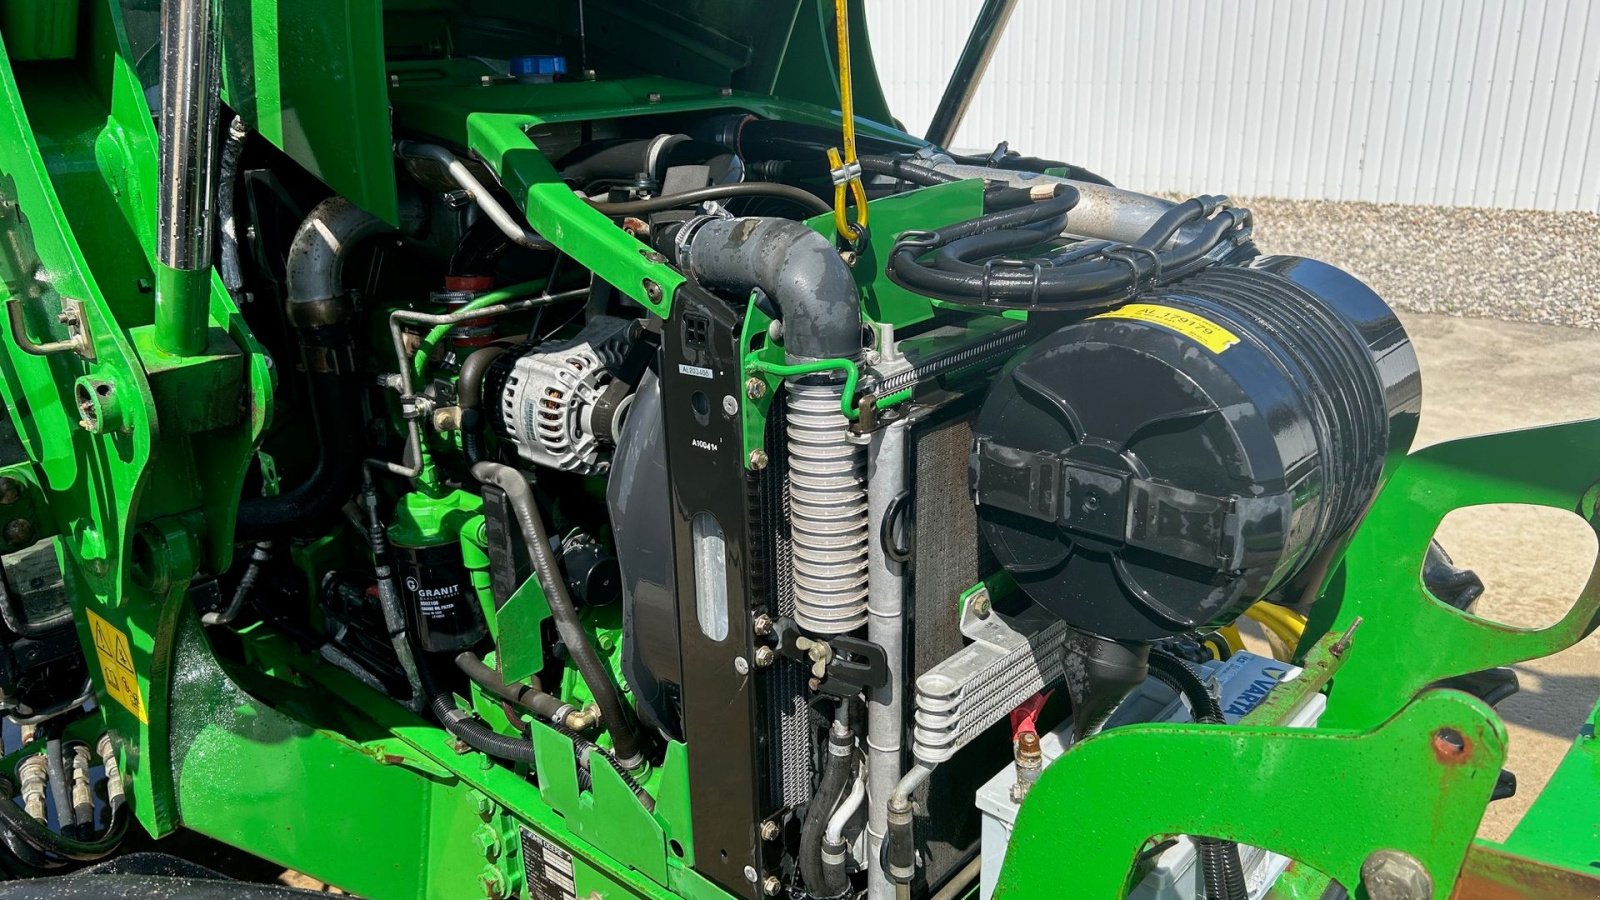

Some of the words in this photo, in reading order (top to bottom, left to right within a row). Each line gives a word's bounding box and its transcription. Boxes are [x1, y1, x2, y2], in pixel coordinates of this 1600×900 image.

[1163, 312, 1214, 335] 179179
[692, 438, 718, 451] A100414
[418, 584, 459, 597] GRANIT
[1224, 679, 1276, 715] VARTA
[527, 832, 542, 845] JOHN
[543, 841, 564, 857] DEERE
